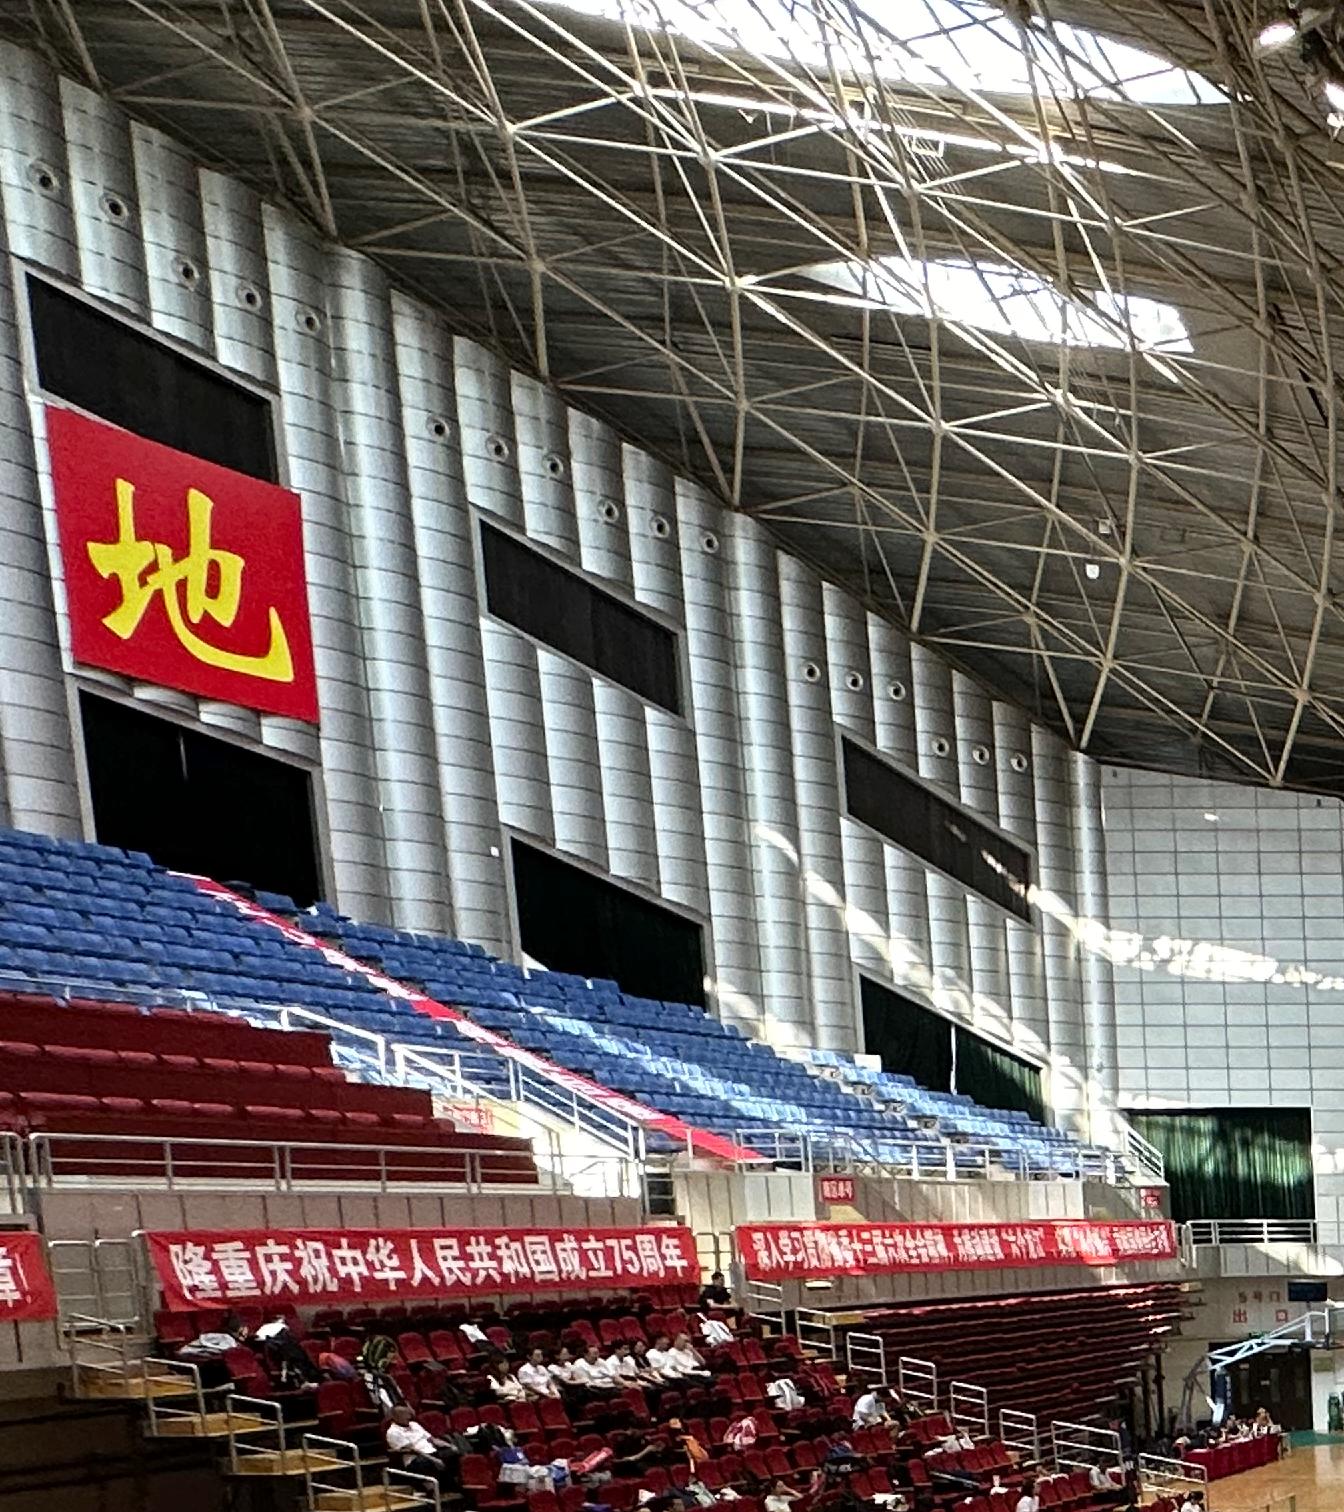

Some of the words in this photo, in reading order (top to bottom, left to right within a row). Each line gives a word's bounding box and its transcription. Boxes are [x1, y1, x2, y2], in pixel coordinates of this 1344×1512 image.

[86, 477, 294, 683] 地
[169, 1234, 688, 1300] 隆重庆祝中华人民共和国成立75周年
